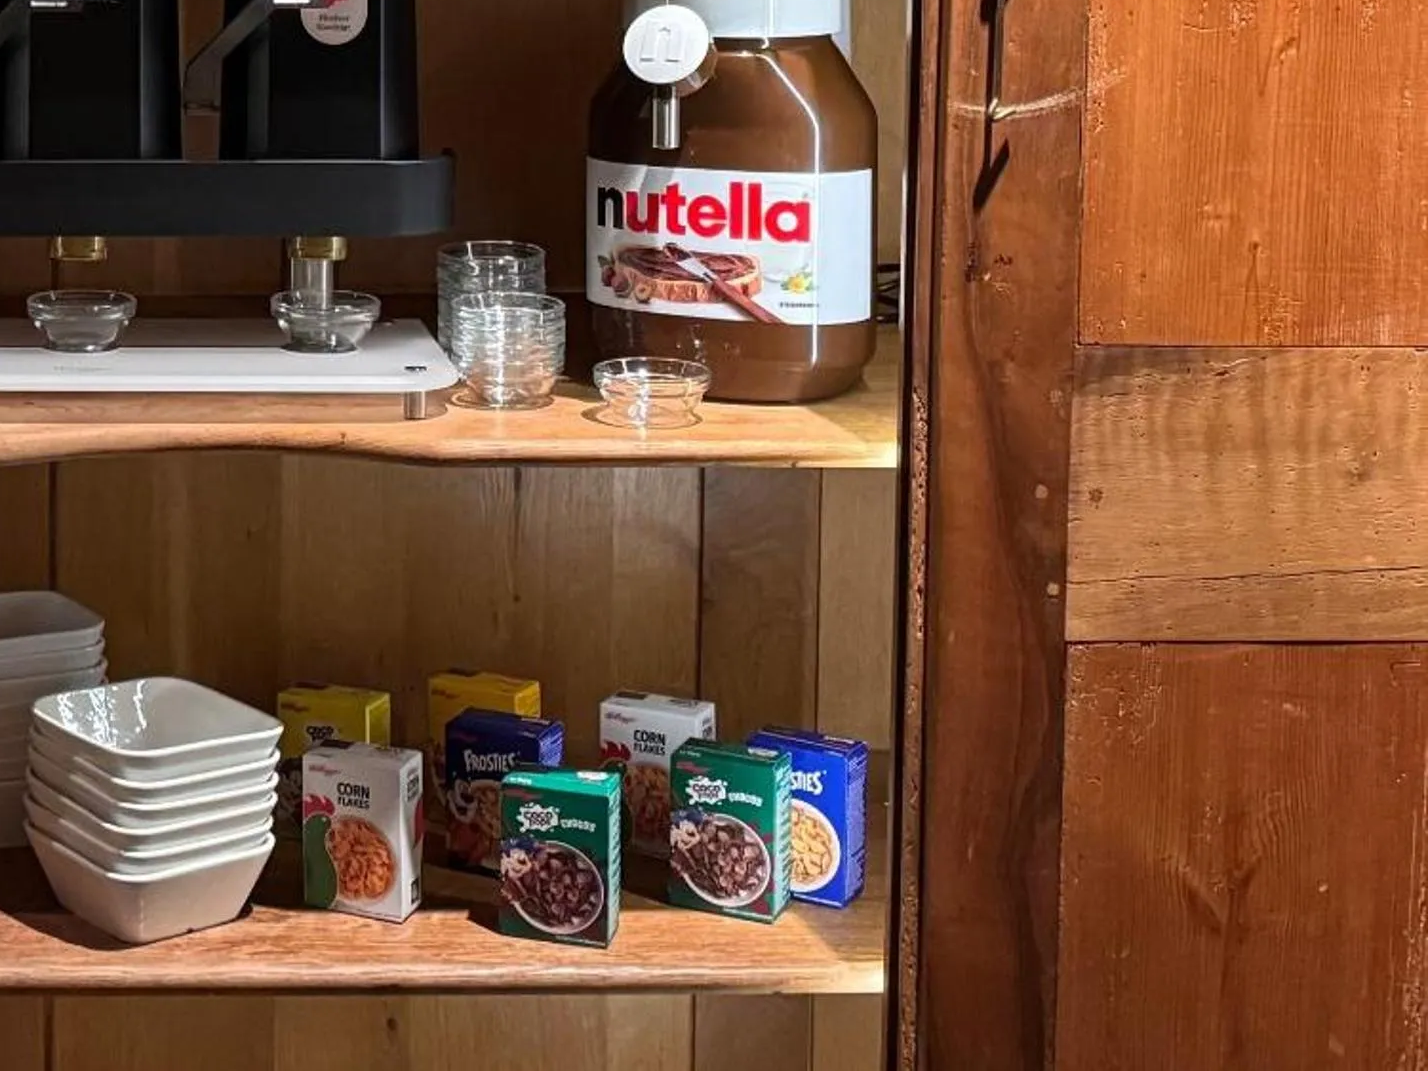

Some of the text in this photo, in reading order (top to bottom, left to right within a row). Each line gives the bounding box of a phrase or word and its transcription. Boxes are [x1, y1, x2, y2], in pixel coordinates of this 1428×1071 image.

[597, 181, 811, 243] nutella
[633, 729, 666, 746] CORN
[633, 742, 666, 757] FLAKES
[336, 782, 370, 799] CORN
[337, 795, 370, 810] FLAKES
